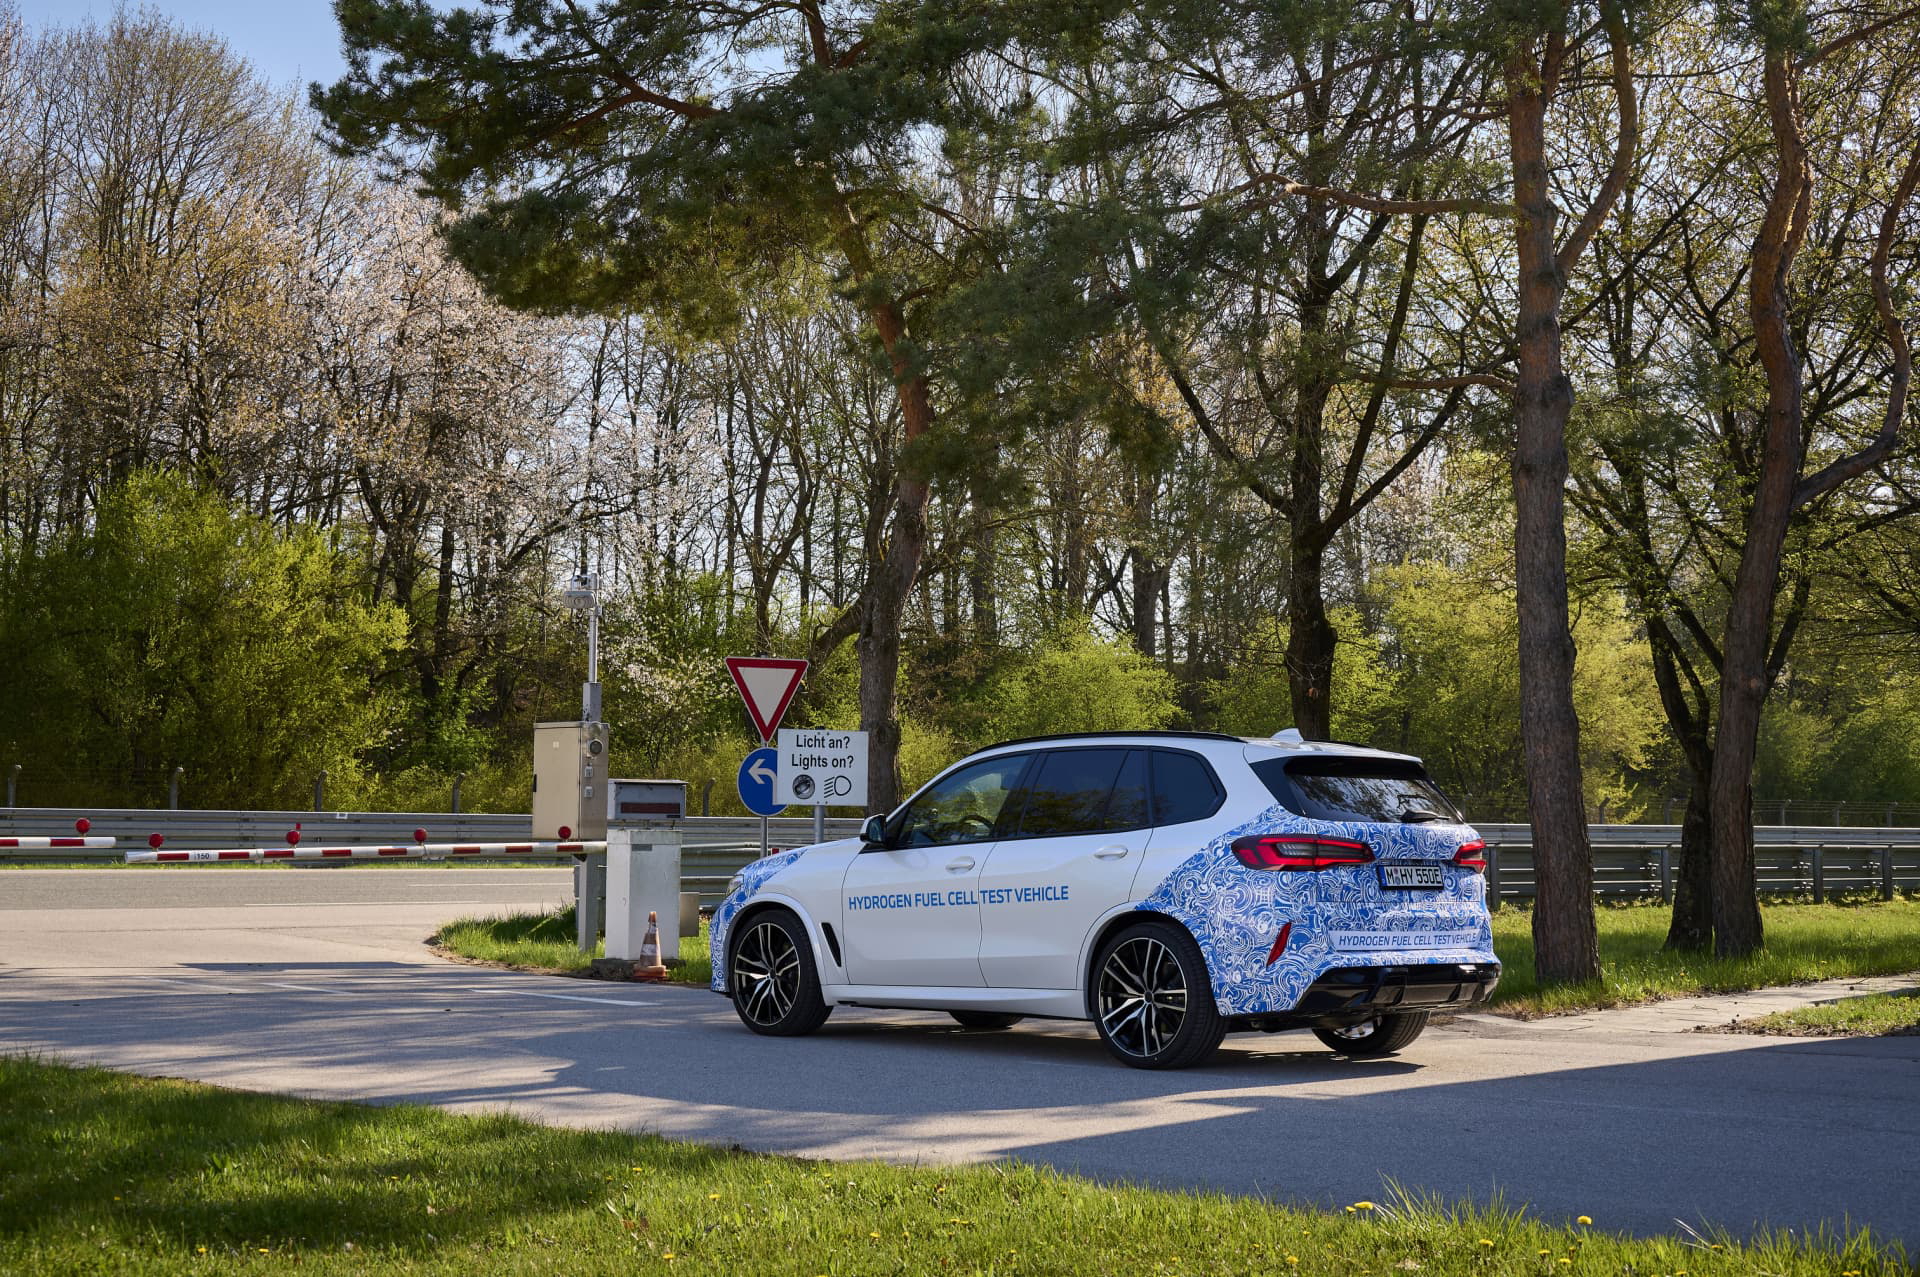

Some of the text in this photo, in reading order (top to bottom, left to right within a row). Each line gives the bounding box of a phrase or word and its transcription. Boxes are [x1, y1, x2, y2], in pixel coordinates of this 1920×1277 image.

[796, 734, 850, 749] Licht an?
[791, 753, 854, 770] Lights on?
[1385, 868, 1442, 884] M HY 550E
[848, 885, 1069, 911] HYDROGEN FUEL CELL TEST VEHICLE
[1339, 932, 1477, 947] HYDROGEN FUEL CELL TEST VEHICLE
